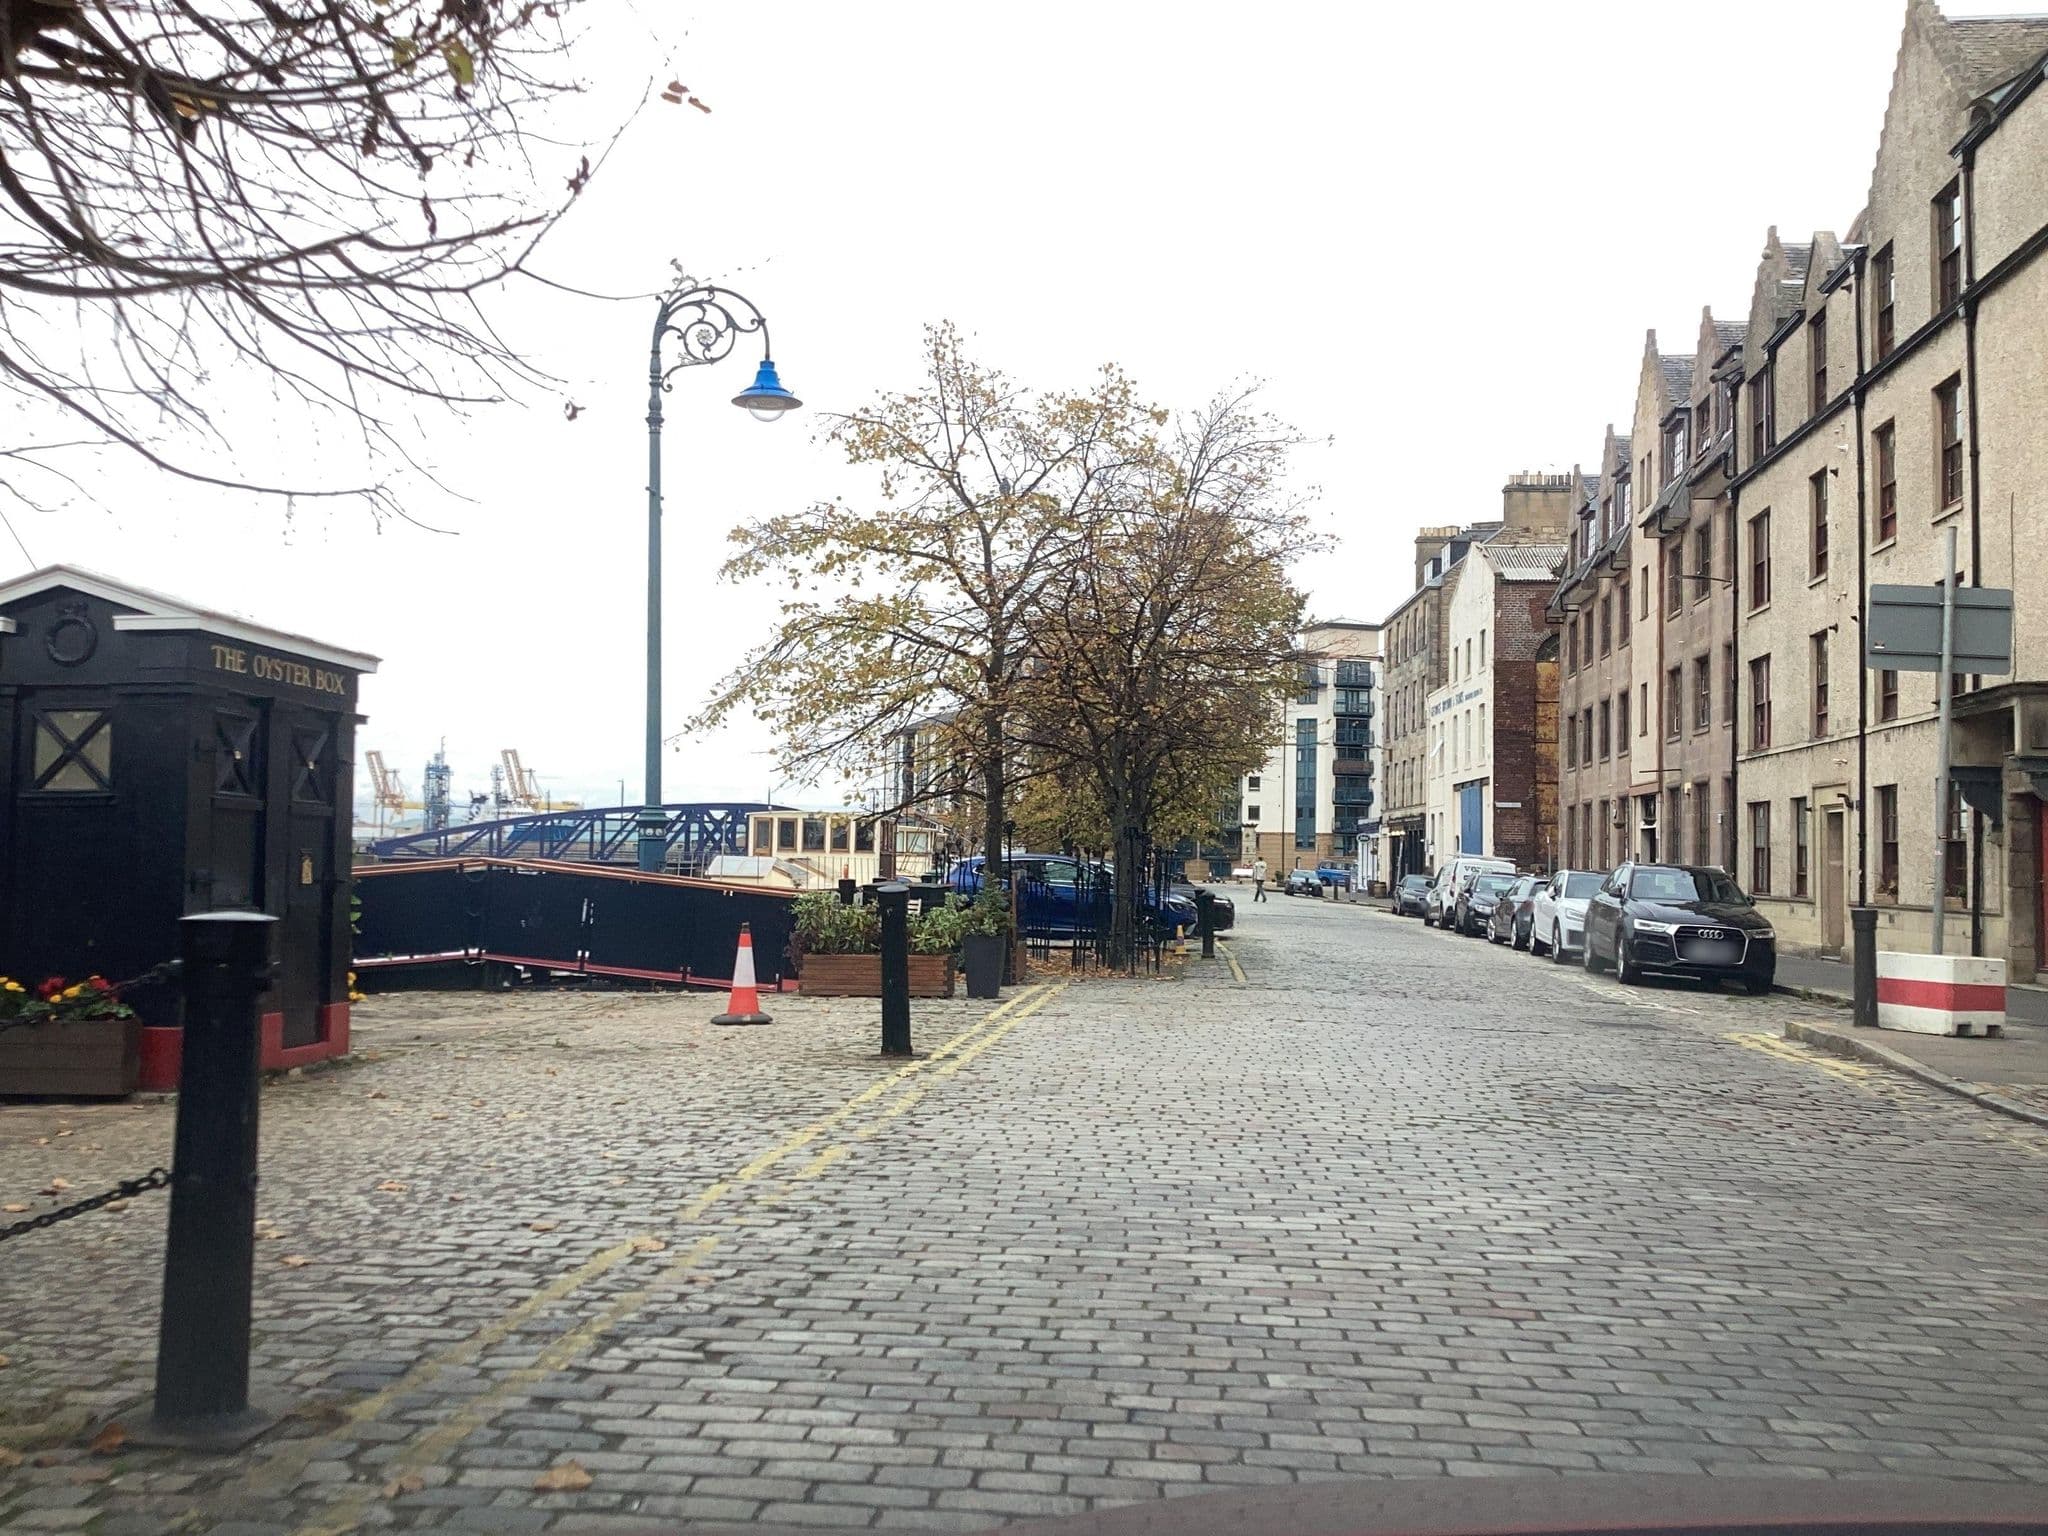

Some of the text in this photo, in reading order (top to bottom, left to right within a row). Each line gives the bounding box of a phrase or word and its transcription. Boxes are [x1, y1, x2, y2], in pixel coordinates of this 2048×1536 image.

[211, 645, 345, 695] THE OYSTER BOX
